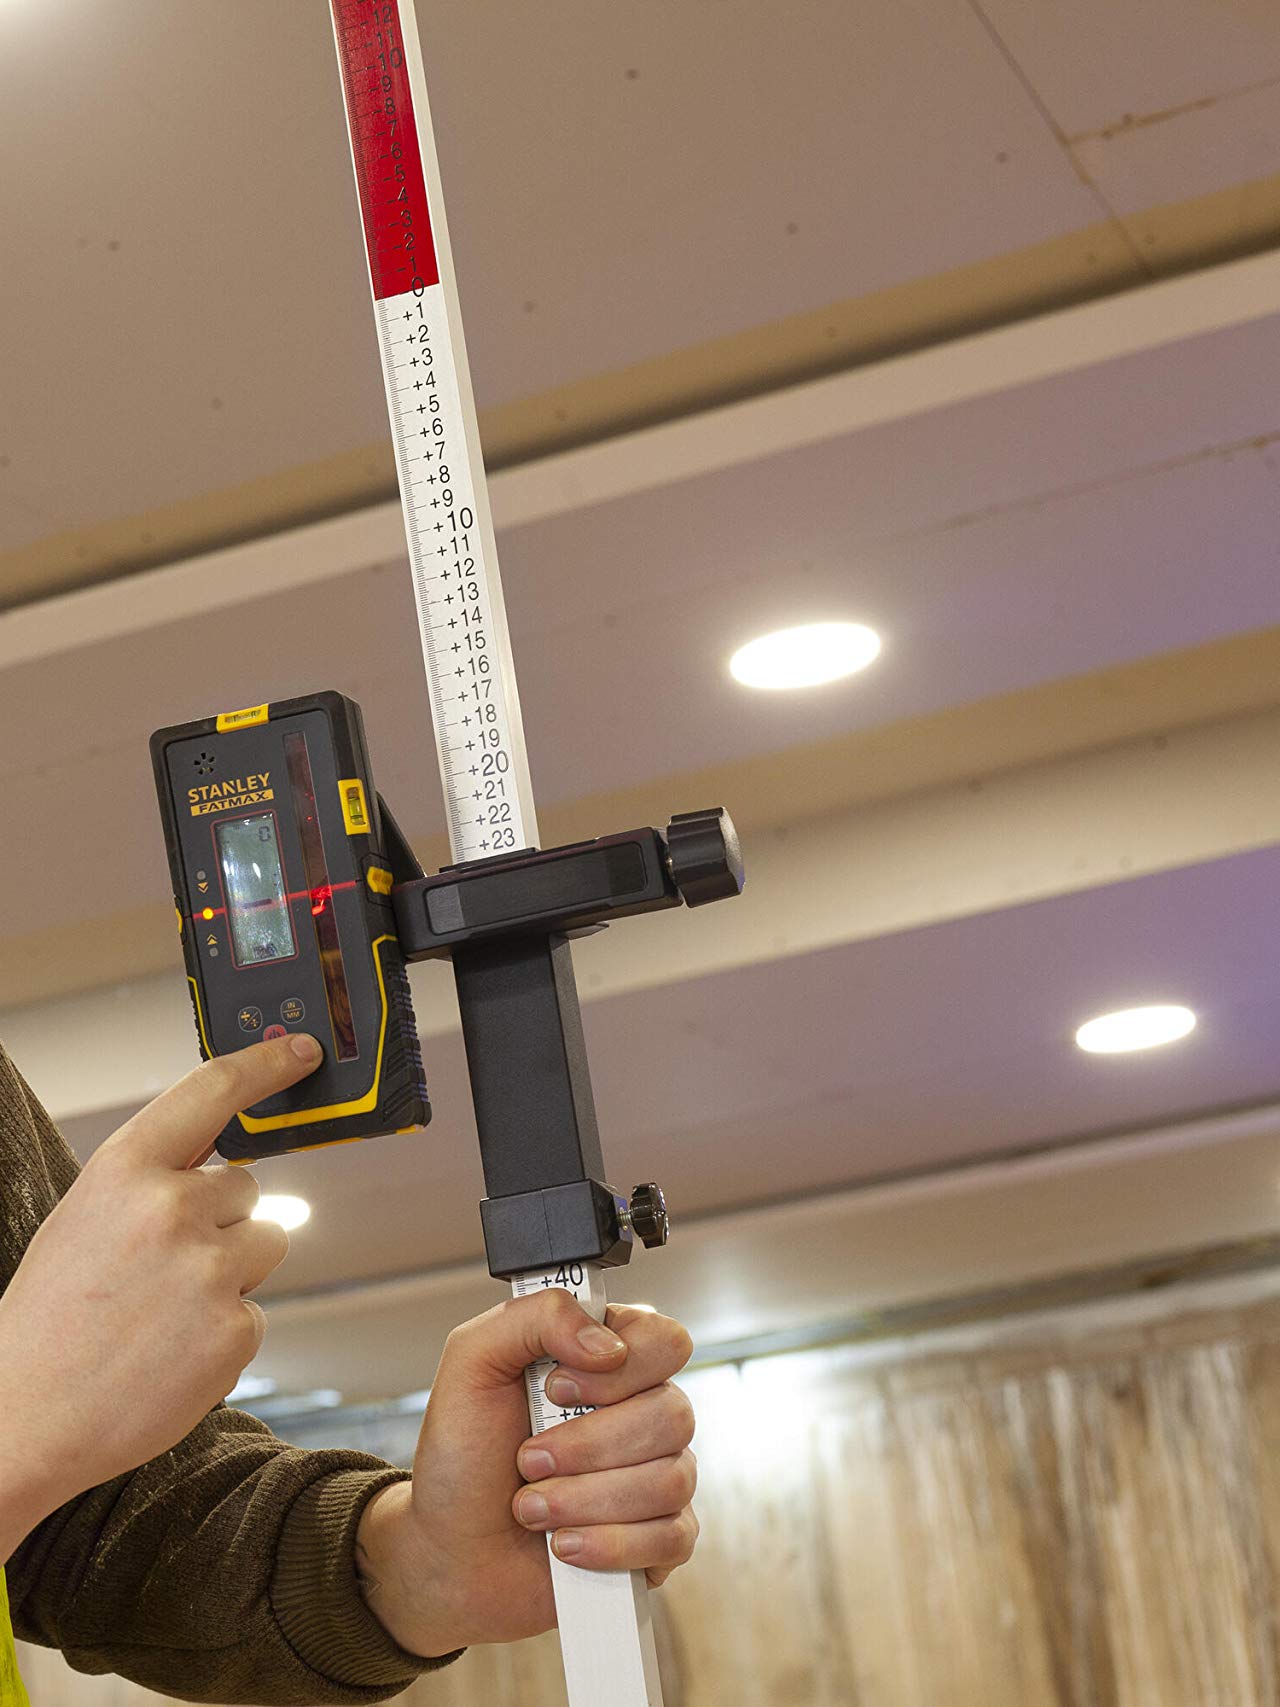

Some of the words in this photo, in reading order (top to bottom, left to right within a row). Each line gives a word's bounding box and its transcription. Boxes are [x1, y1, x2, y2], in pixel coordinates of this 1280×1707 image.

[411, 276, 425, 297] 0
[402, 301, 424, 321] +1
[406, 324, 430, 344] +2
[409, 347, 433, 367] +3
[412, 370, 437, 391] +4
[416, 394, 440, 414] +5
[420, 417, 444, 438] +6
[423, 441, 446, 461] +7
[426, 465, 451, 485] +8
[430, 488, 453, 508] +9
[433, 507, 474, 532] +10
[437, 534, 470, 556] +11
[440, 558, 476, 581] +12
[444, 581, 480, 605] +13
[447, 606, 483, 629] +14
[451, 630, 487, 653] +15
[454, 654, 490, 677] +16
[458, 679, 492, 702] +17
[461, 703, 497, 726] +18
[465, 728, 500, 751] +19
[468, 750, 509, 777] +20
[188, 771, 270, 804] STANLEY
[472, 777, 506, 801] +21
[199, 791, 268, 814] FATMAX
[475, 802, 512, 825] +22
[479, 827, 515, 850] +23
[540, 1263, 584, 1288] +40
